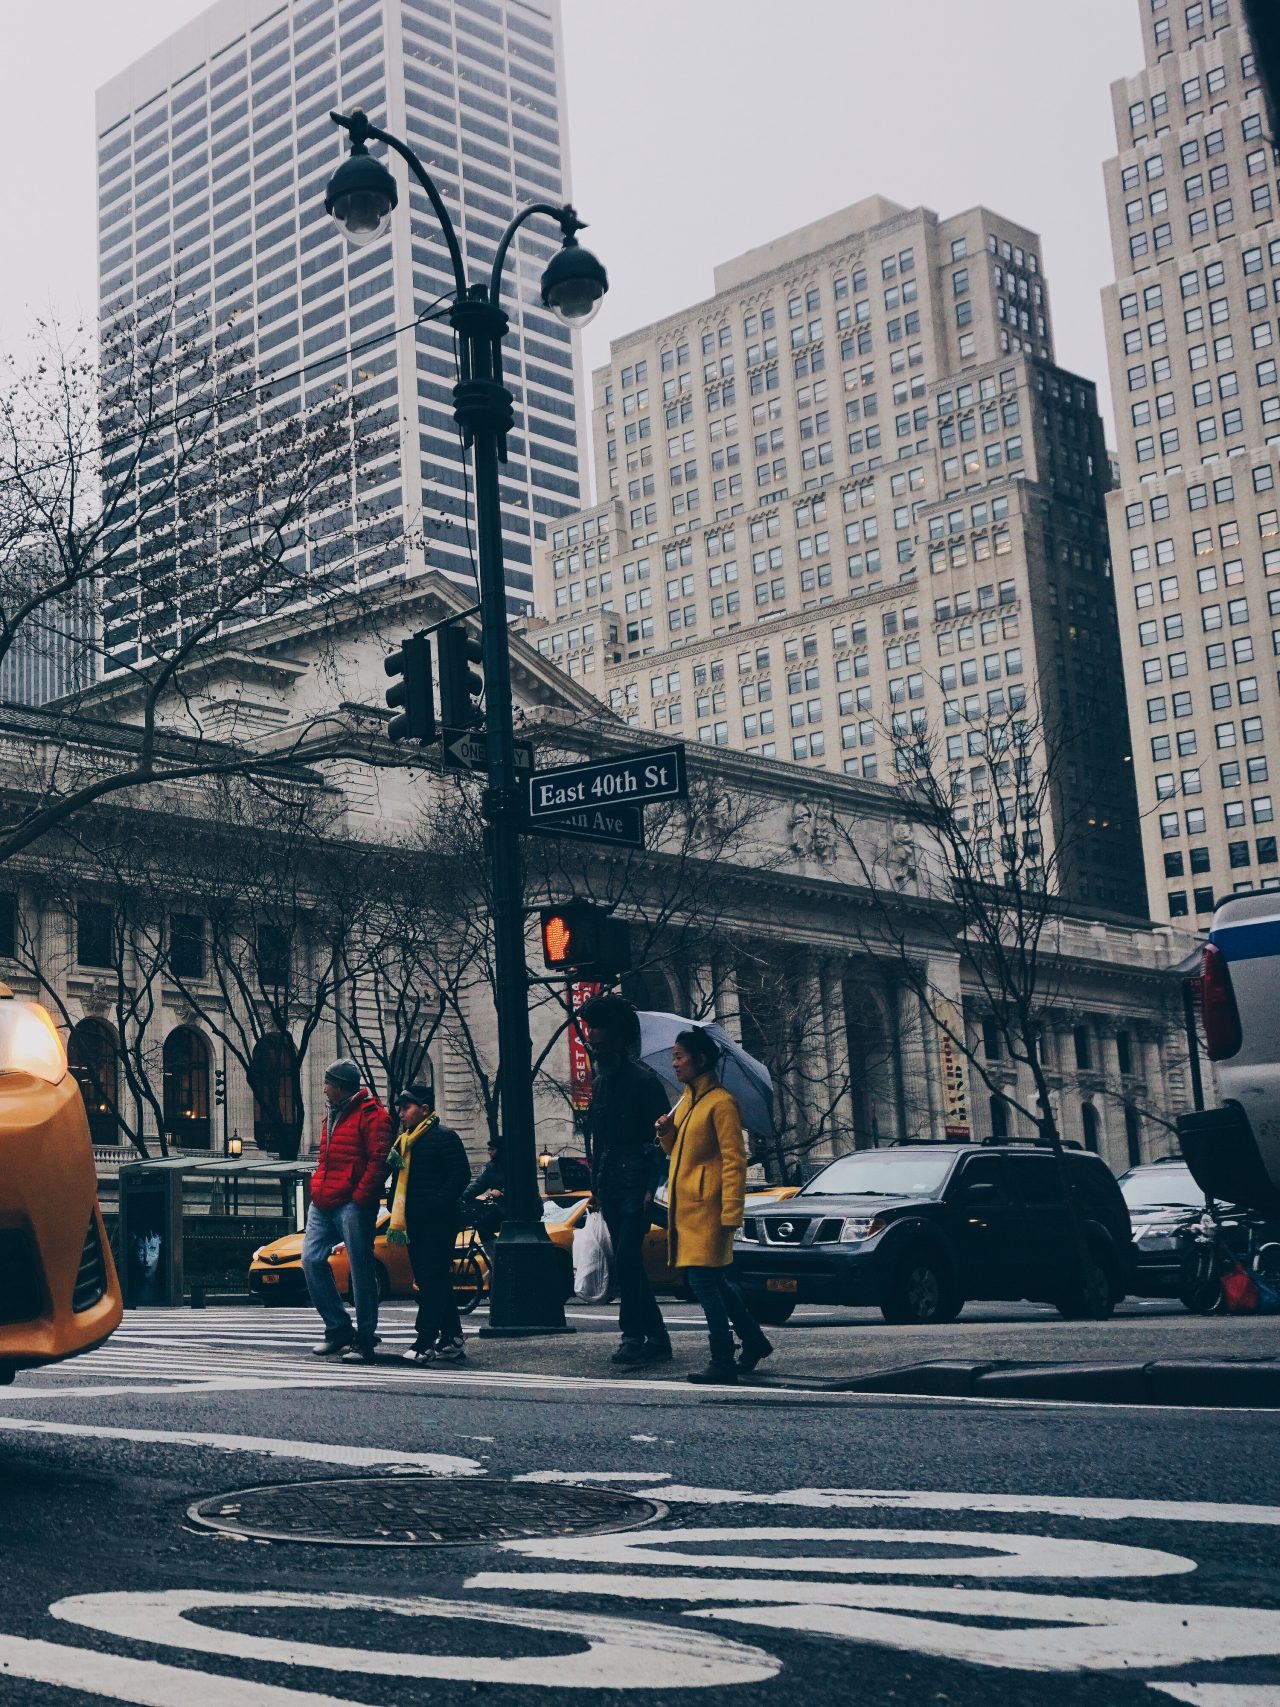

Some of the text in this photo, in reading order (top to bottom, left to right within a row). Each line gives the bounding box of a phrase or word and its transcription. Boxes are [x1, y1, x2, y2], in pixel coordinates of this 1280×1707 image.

[461, 743, 486, 760] ONE
[539, 765, 668, 807] East 40th St
[593, 811, 623, 833] Ave
[575, 1050, 586, 1081] GET
